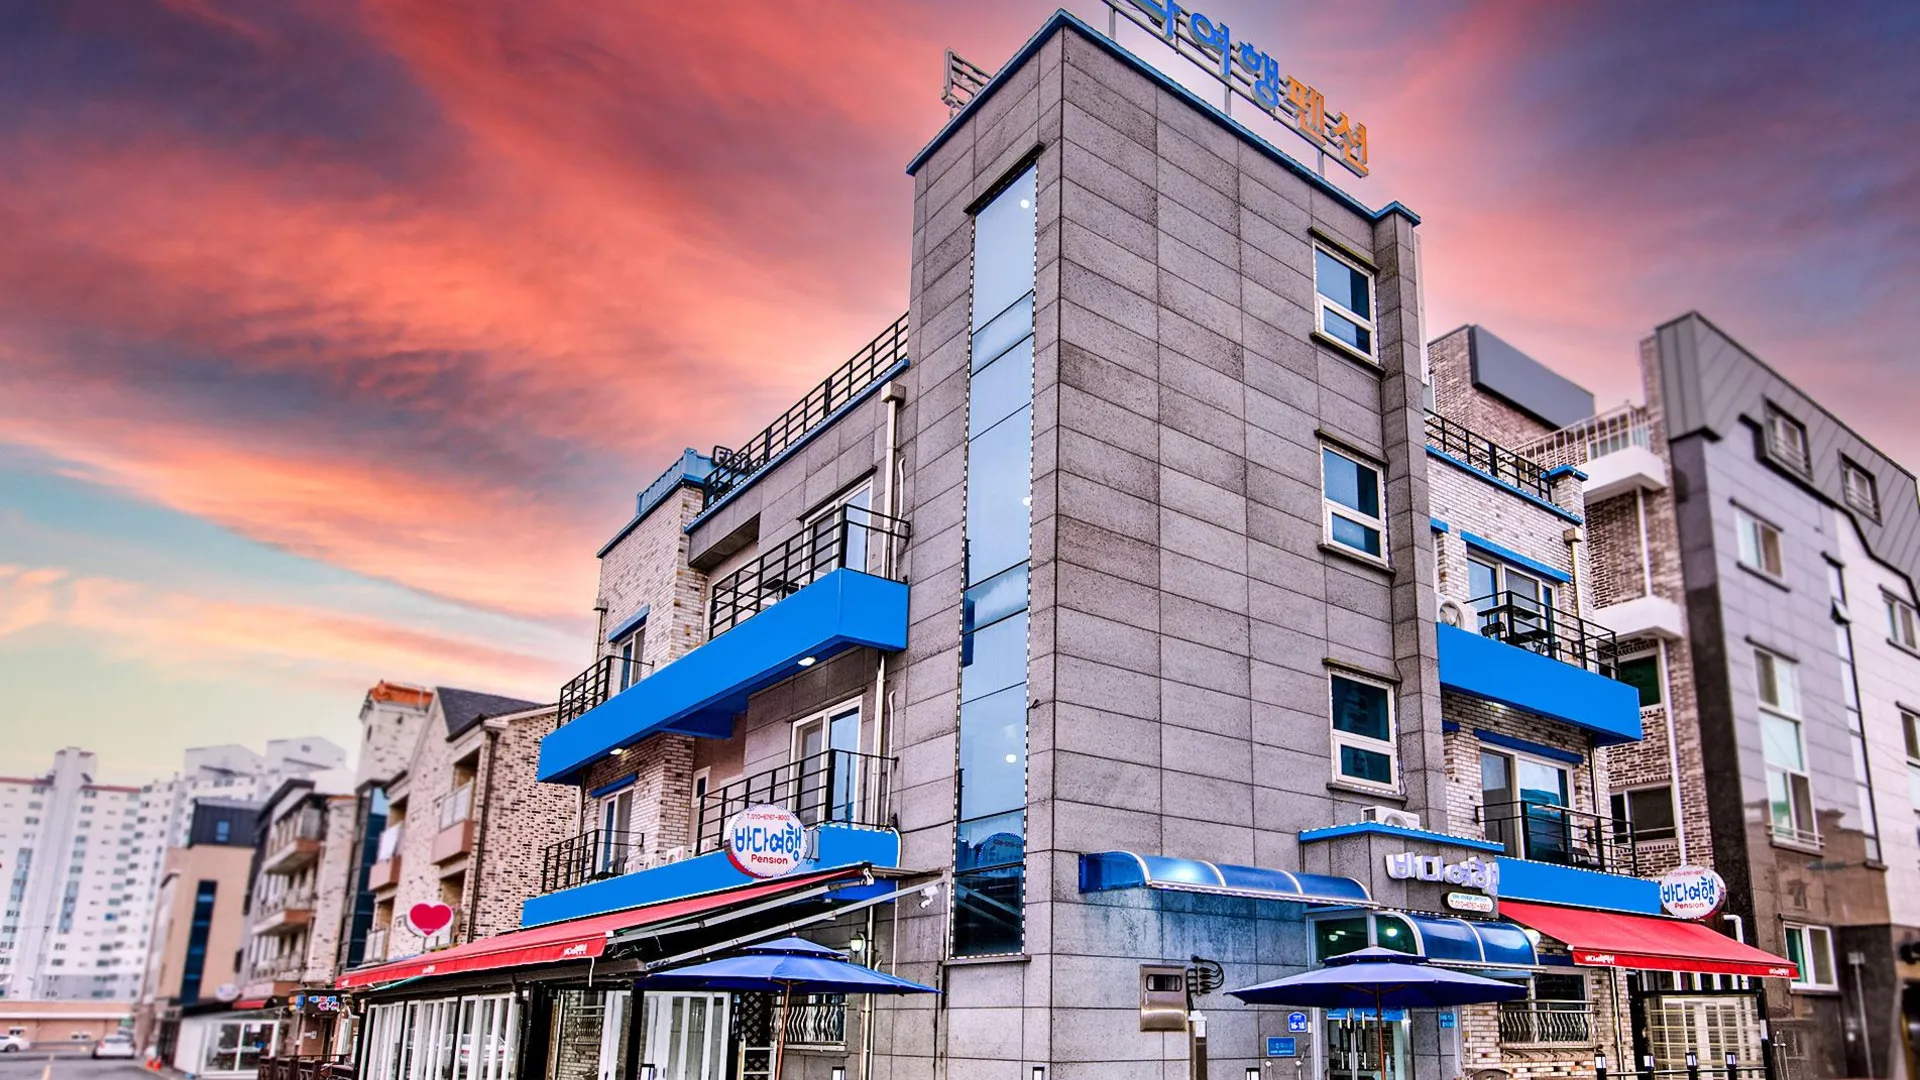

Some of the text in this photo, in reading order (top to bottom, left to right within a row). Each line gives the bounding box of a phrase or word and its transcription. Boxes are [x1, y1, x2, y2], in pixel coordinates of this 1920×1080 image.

[735, 822, 802, 862] 바다여행
[751, 854, 788, 865] Pension
[1662, 876, 1715, 905] 바다여행
[1674, 902, 1705, 910] Pension
